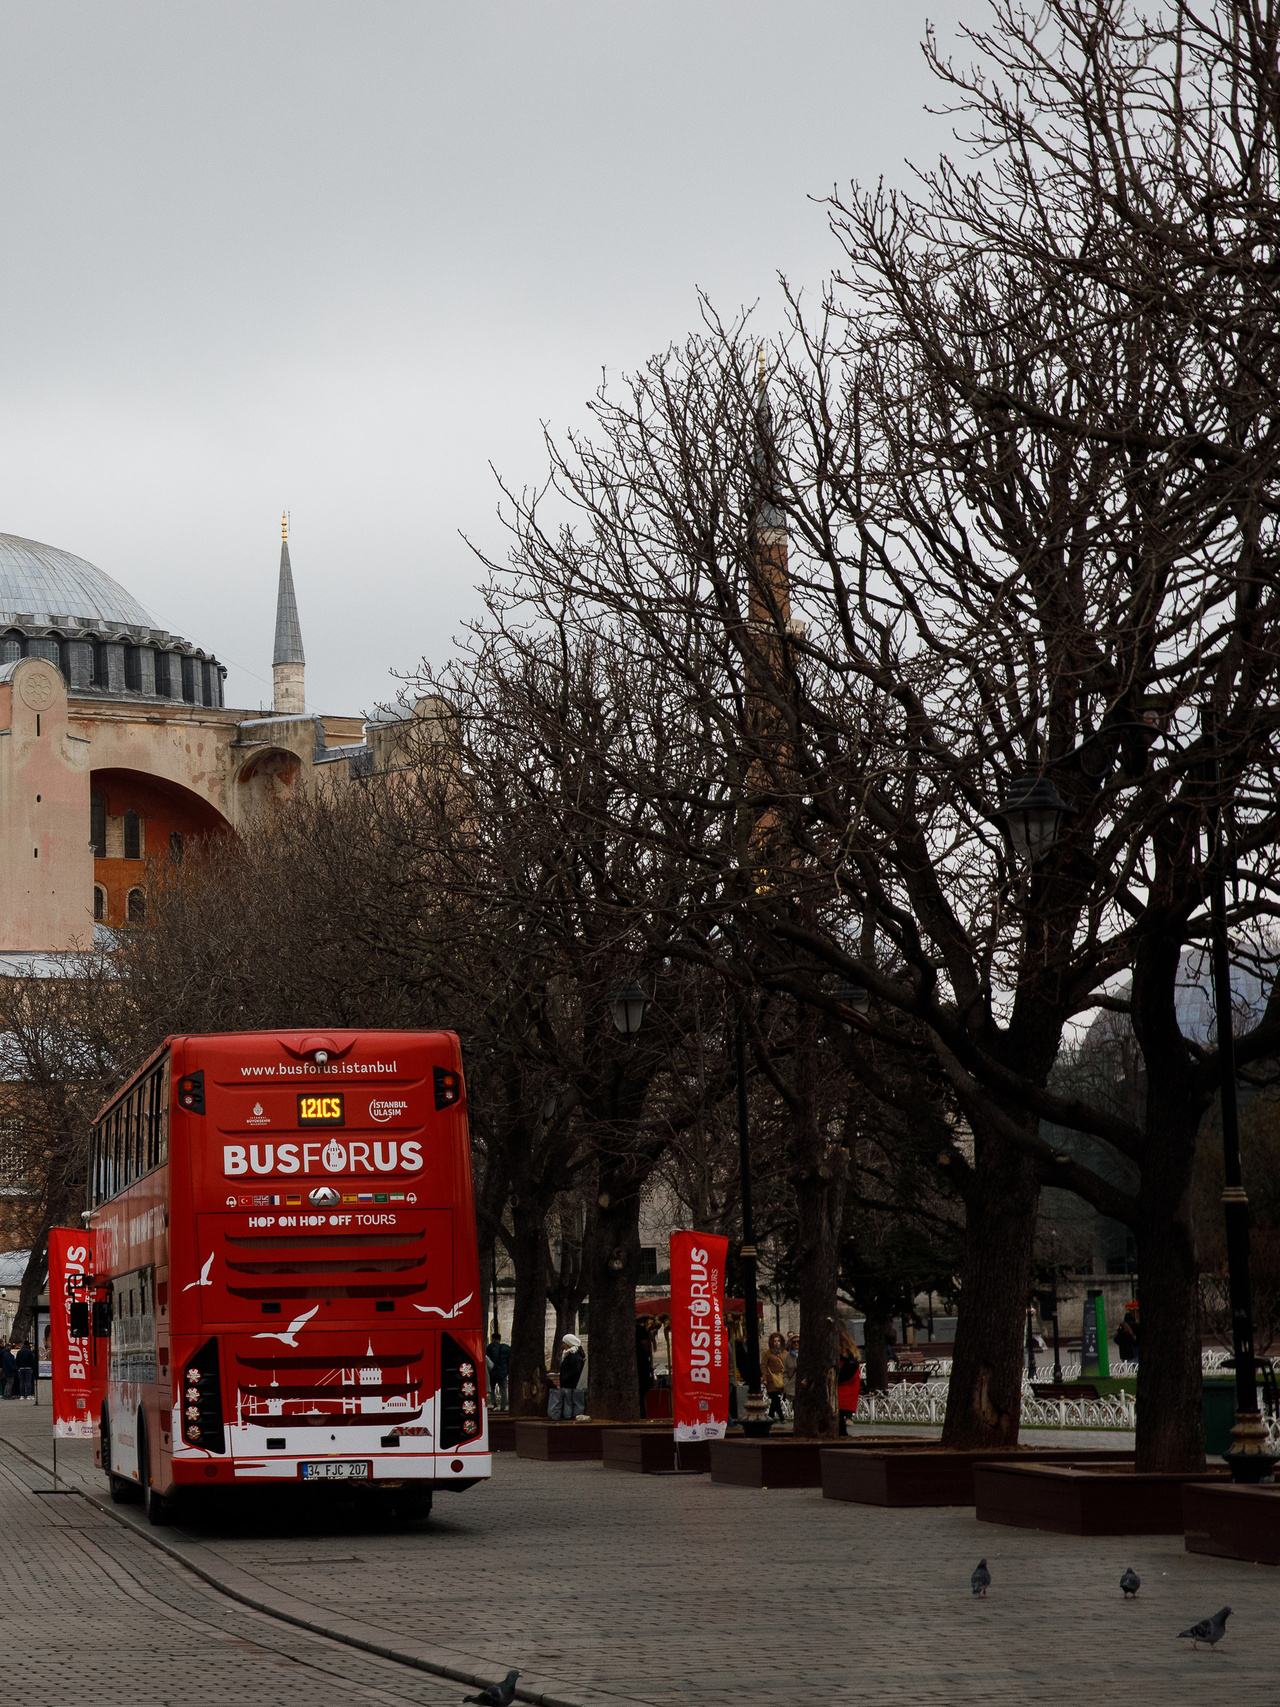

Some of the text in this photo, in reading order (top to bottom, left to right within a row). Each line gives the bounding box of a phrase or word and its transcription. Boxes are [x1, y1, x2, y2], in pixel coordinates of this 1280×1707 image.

[241, 1061, 397, 1076] www.busforus.istanbul
[300, 1097, 341, 1118] 121CS
[223, 1140, 424, 1175] BUSFORUS
[248, 1214, 397, 1228] HOP ON HOP OFF TOURS
[711, 1268, 719, 1294] TOURS
[690, 1247, 711, 1384] BUSFORUS
[714, 1313, 722, 1332] HOP
[714, 1333, 722, 1347] ON
[714, 1348, 722, 1367] HOP
[387, 1426, 433, 1437] AKIA
[308, 1464, 367, 1476] 34 FJC 207
